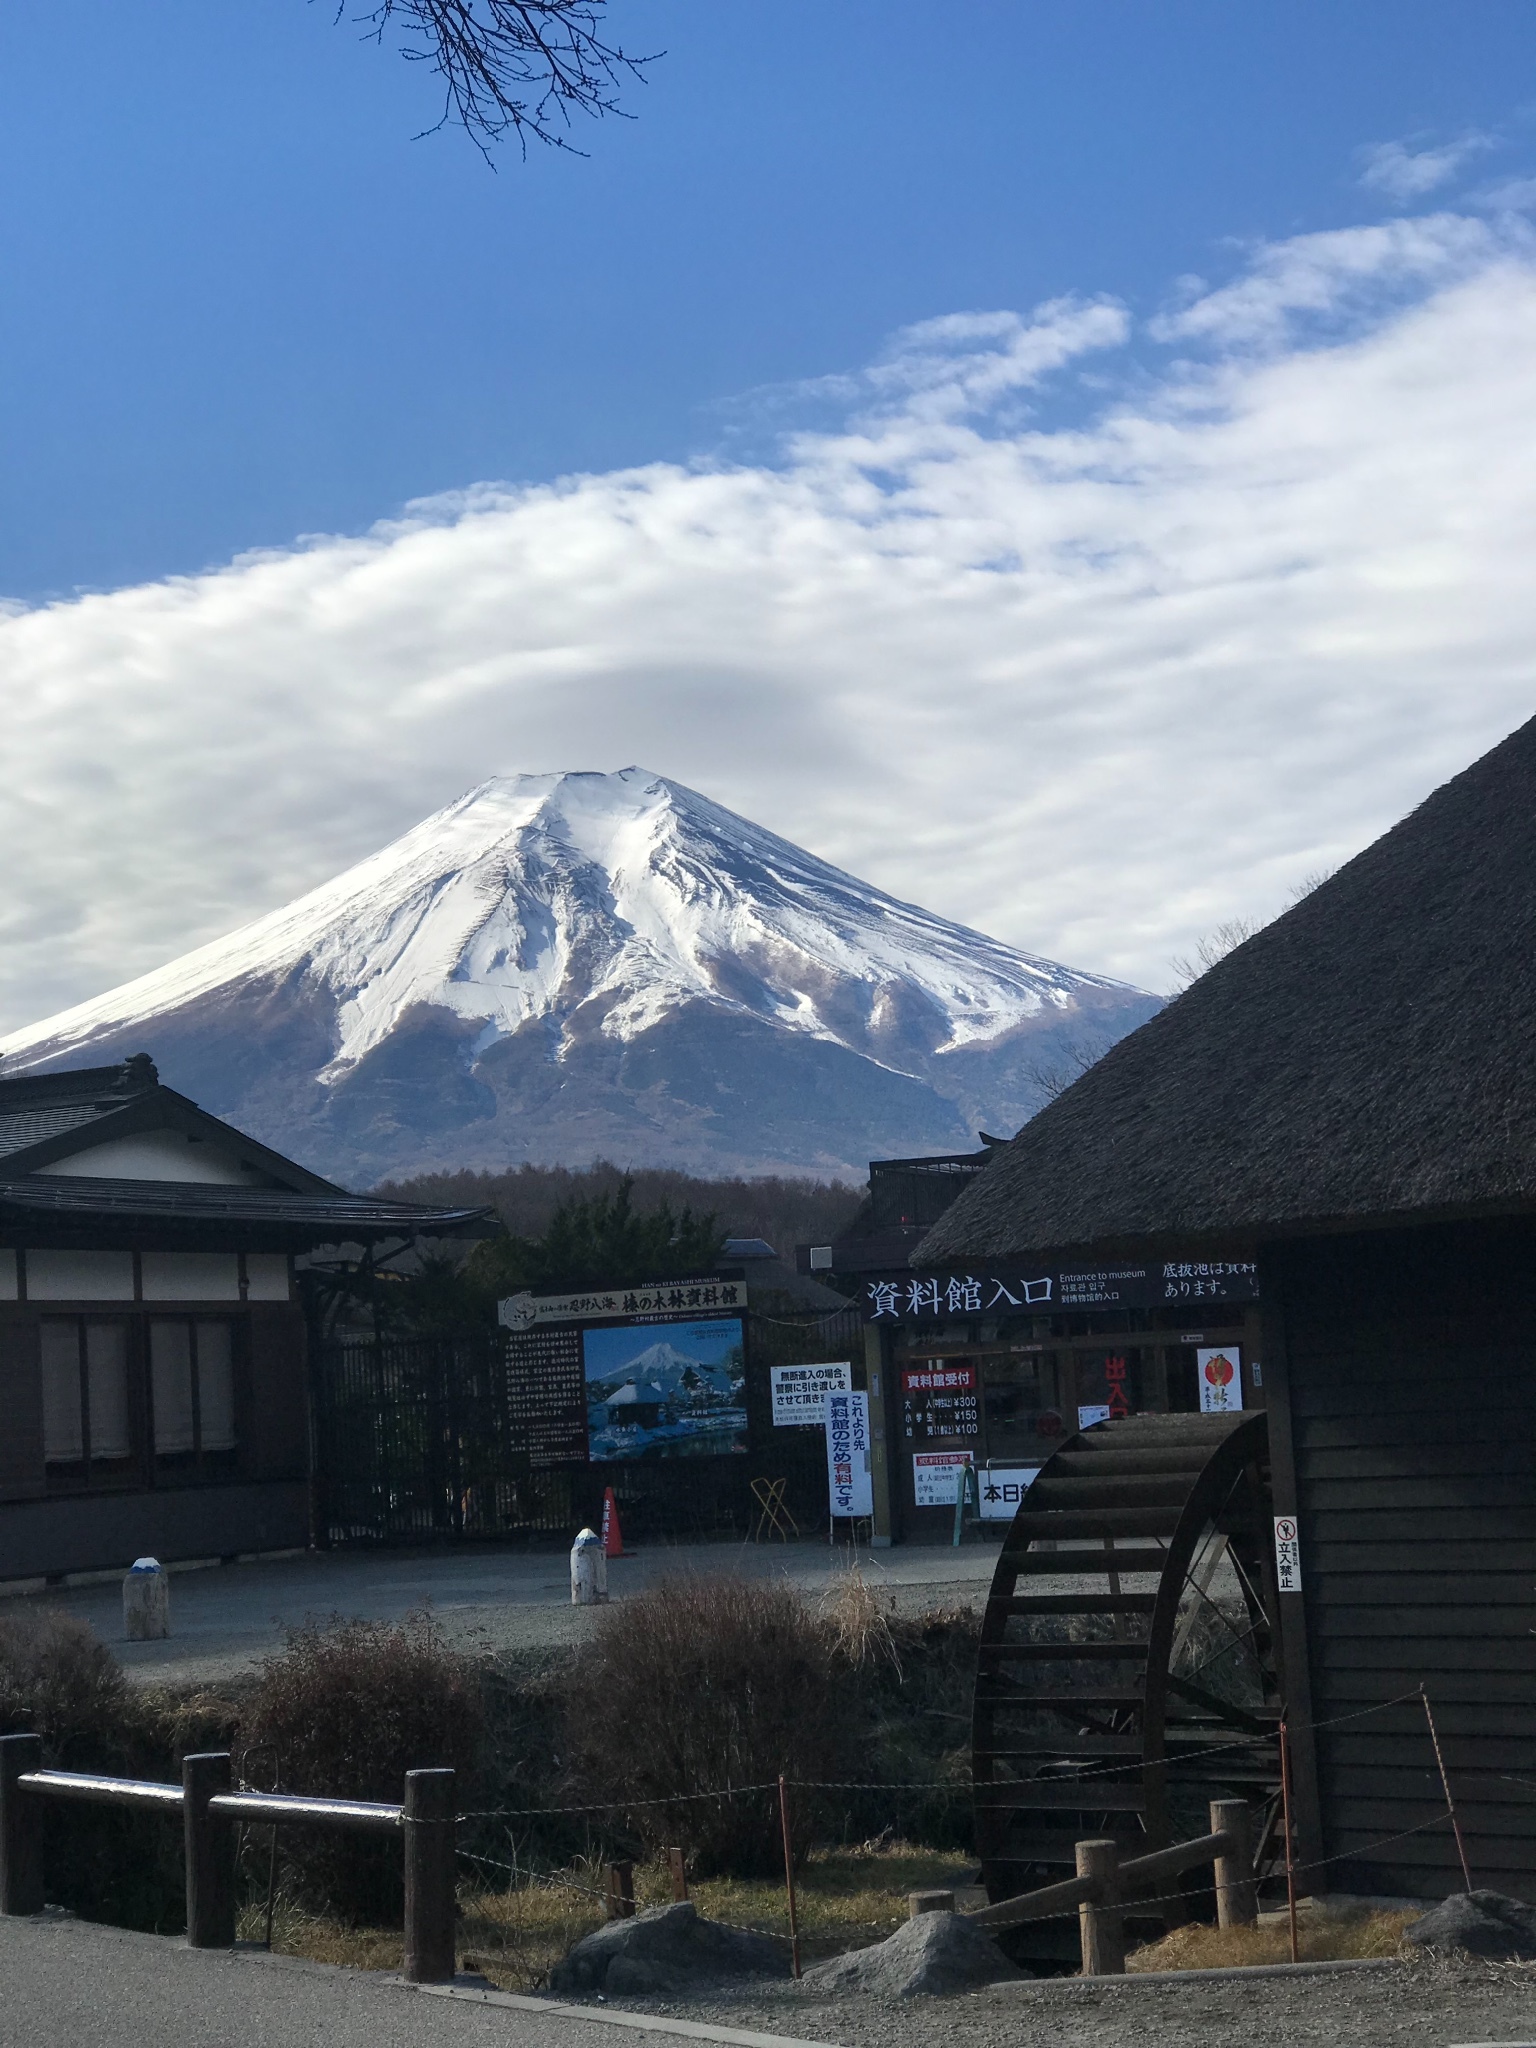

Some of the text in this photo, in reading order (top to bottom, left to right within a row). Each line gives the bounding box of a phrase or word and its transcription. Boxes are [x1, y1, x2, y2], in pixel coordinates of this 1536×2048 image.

[694, 1276, 721, 1285] MUSEUM
[1059, 1270, 1146, 1284] Entrance to museum
[1060, 1281, 1106, 1293] 자료관 입구
[1164, 1279, 1227, 1298] あります。
[867, 1275, 1053, 1319] 資料館入口
[781, 1368, 846, 1382] 無断進入の場合、
[907, 1371, 970, 1388] 資料館受付
[776, 1381, 846, 1395] 警察に引き渡しを
[954, 1396, 977, 1408] ¥300
[954, 1410, 977, 1421] ¥150
[851, 1395, 865, 1451] これより先
[955, 1423, 978, 1435] ¥100
[830, 1397, 854, 1512] 資料館のため有料です。
[1278, 1542, 1294, 1588] 立入禁止
